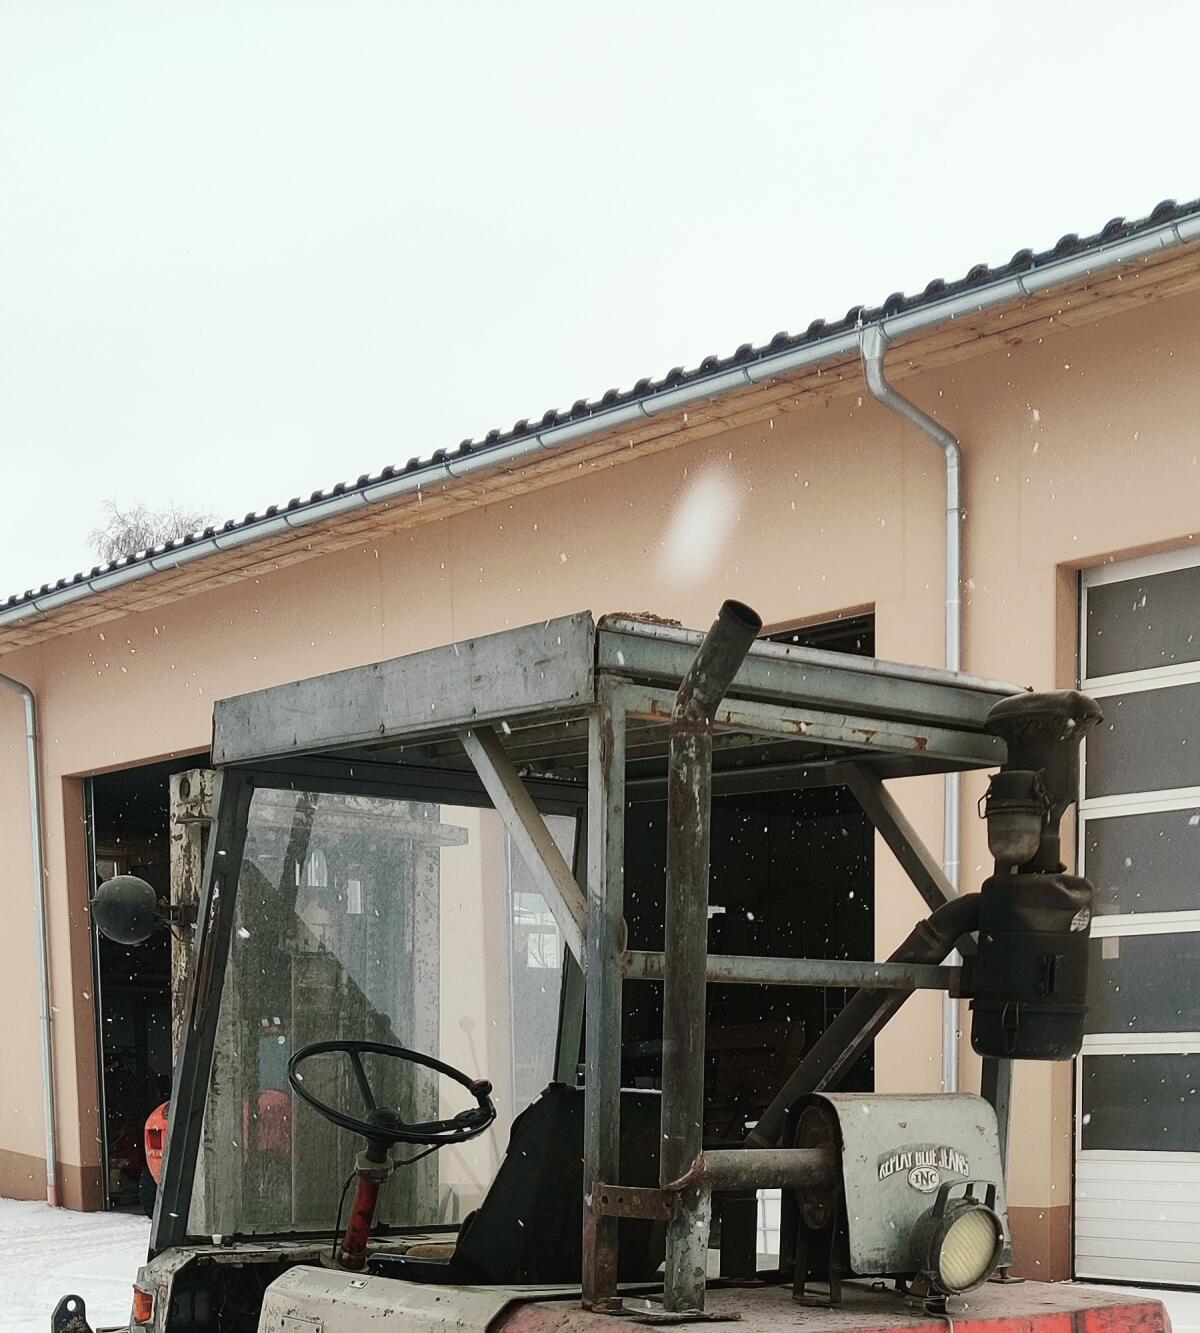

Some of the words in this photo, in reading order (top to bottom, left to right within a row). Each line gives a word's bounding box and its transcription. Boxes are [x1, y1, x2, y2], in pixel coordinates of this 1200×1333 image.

[879, 1151, 912, 1180] REPLAY
[915, 1149, 938, 1167] BLUE
[938, 1146, 969, 1177] JEANS
[914, 1170, 936, 1186] INC
